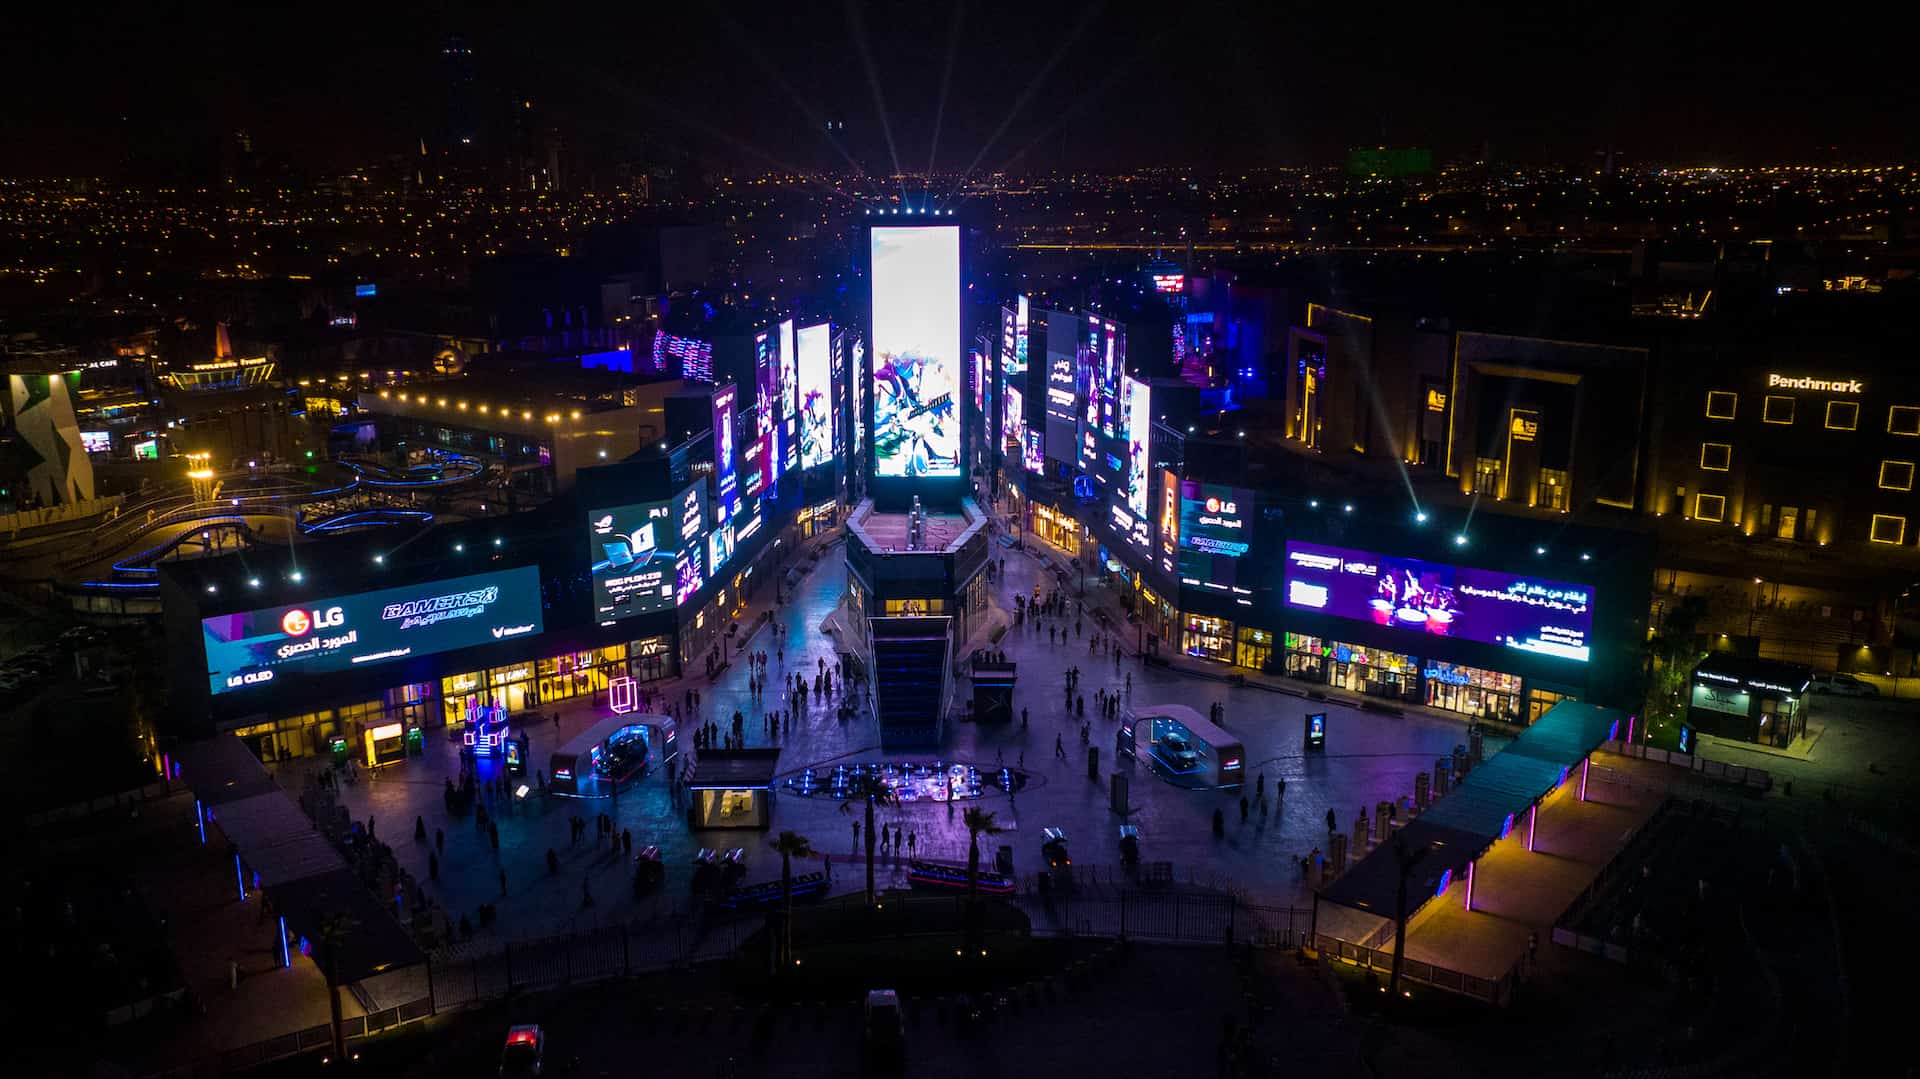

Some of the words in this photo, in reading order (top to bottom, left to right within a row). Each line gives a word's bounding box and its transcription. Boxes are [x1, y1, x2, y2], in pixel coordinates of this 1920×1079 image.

[1769, 373, 1864, 394] Benchmark
[312, 606, 345, 629] LG
[277, 637, 320, 659] الحصري
[323, 630, 357, 649] المورد
[226, 676, 243, 688] LG
[244, 670, 274, 684] OLED
